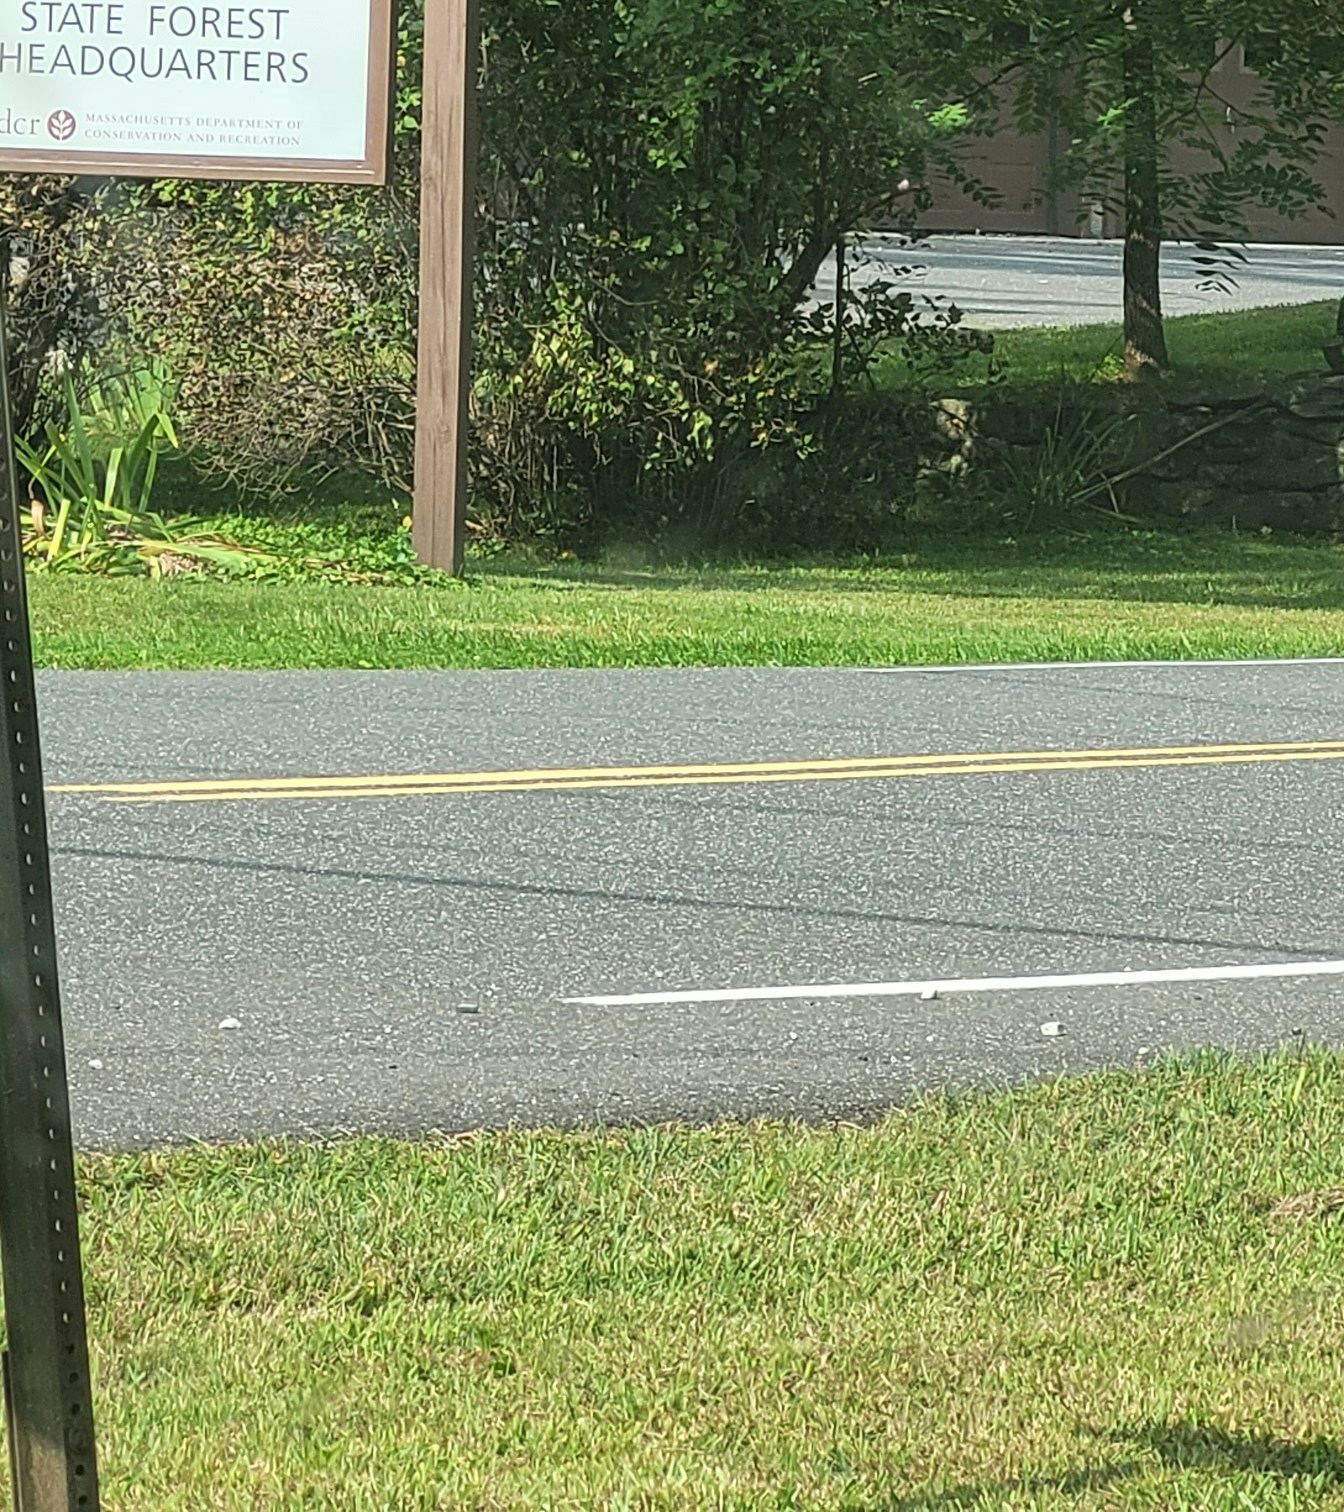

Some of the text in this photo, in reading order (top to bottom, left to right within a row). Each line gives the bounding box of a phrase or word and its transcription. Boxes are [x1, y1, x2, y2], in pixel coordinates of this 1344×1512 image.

[20, 1, 290, 40] STATE FOREST
[84, 112, 304, 130] MASSACHUSETTS DEPARTMENT OF
[84, 129, 301, 146] CONSERVATION AND RECREATION
